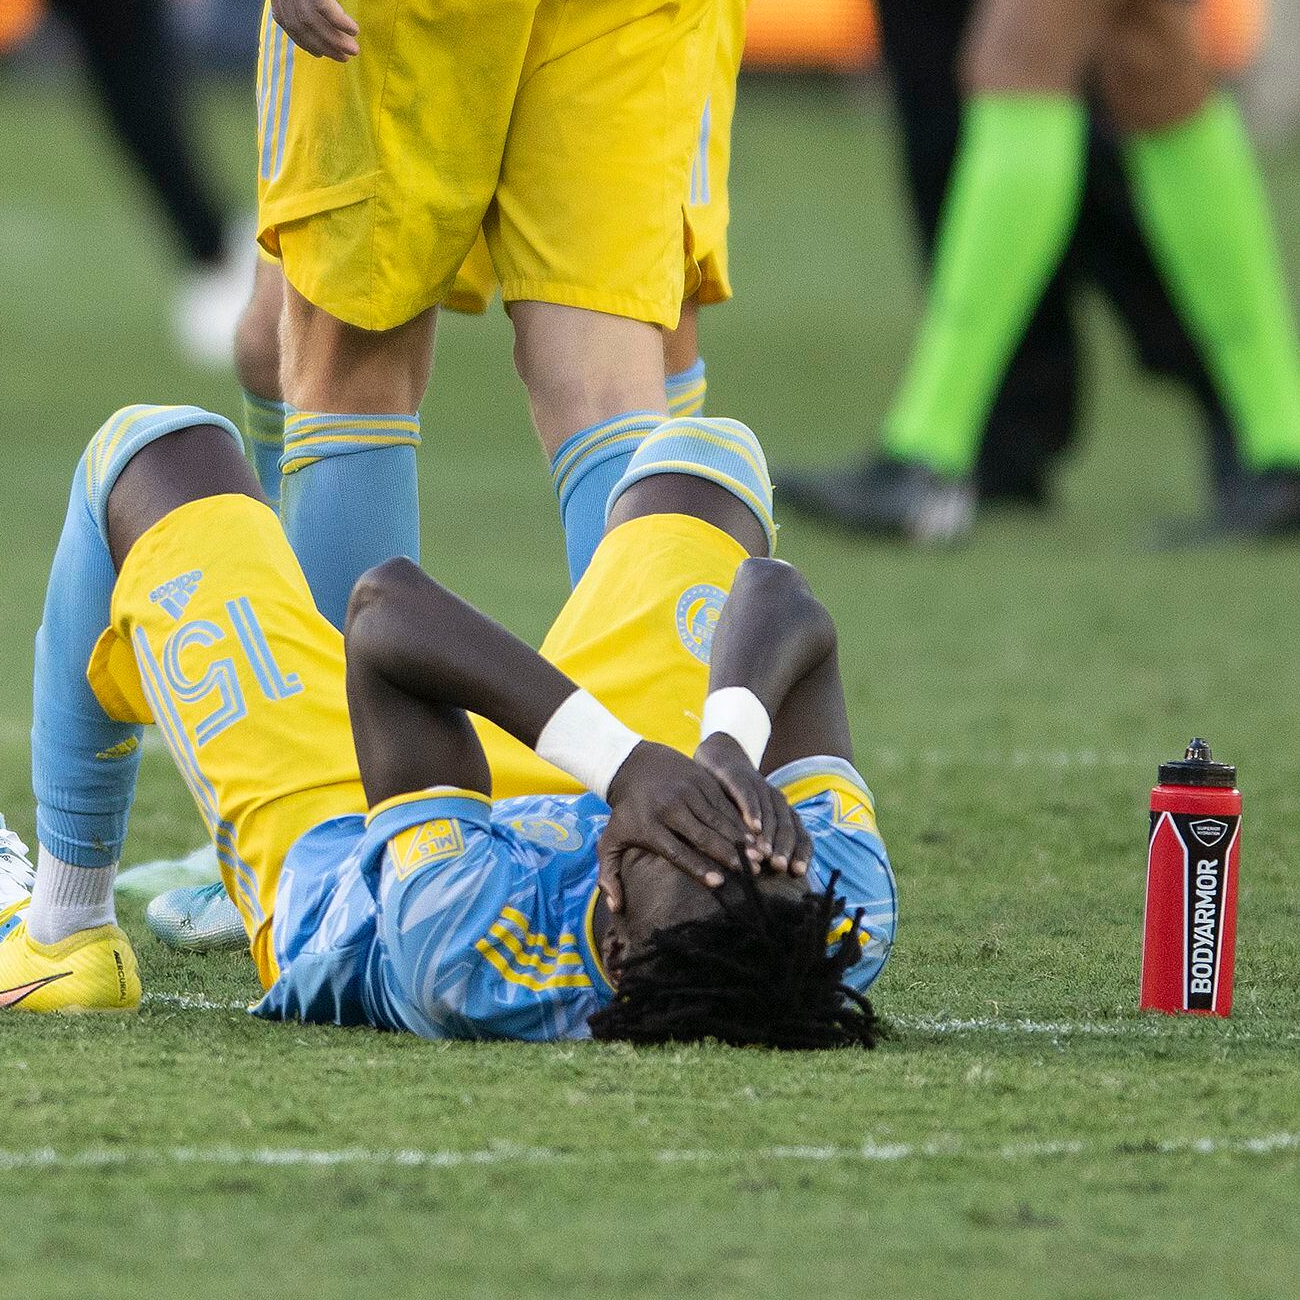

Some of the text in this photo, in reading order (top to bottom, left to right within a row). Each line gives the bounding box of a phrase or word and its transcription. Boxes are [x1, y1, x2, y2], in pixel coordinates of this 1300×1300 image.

[163, 596, 304, 747] 15
[113, 950, 127, 1001] MERCURIAL
[1191, 859, 1218, 994] BODYARMOR
